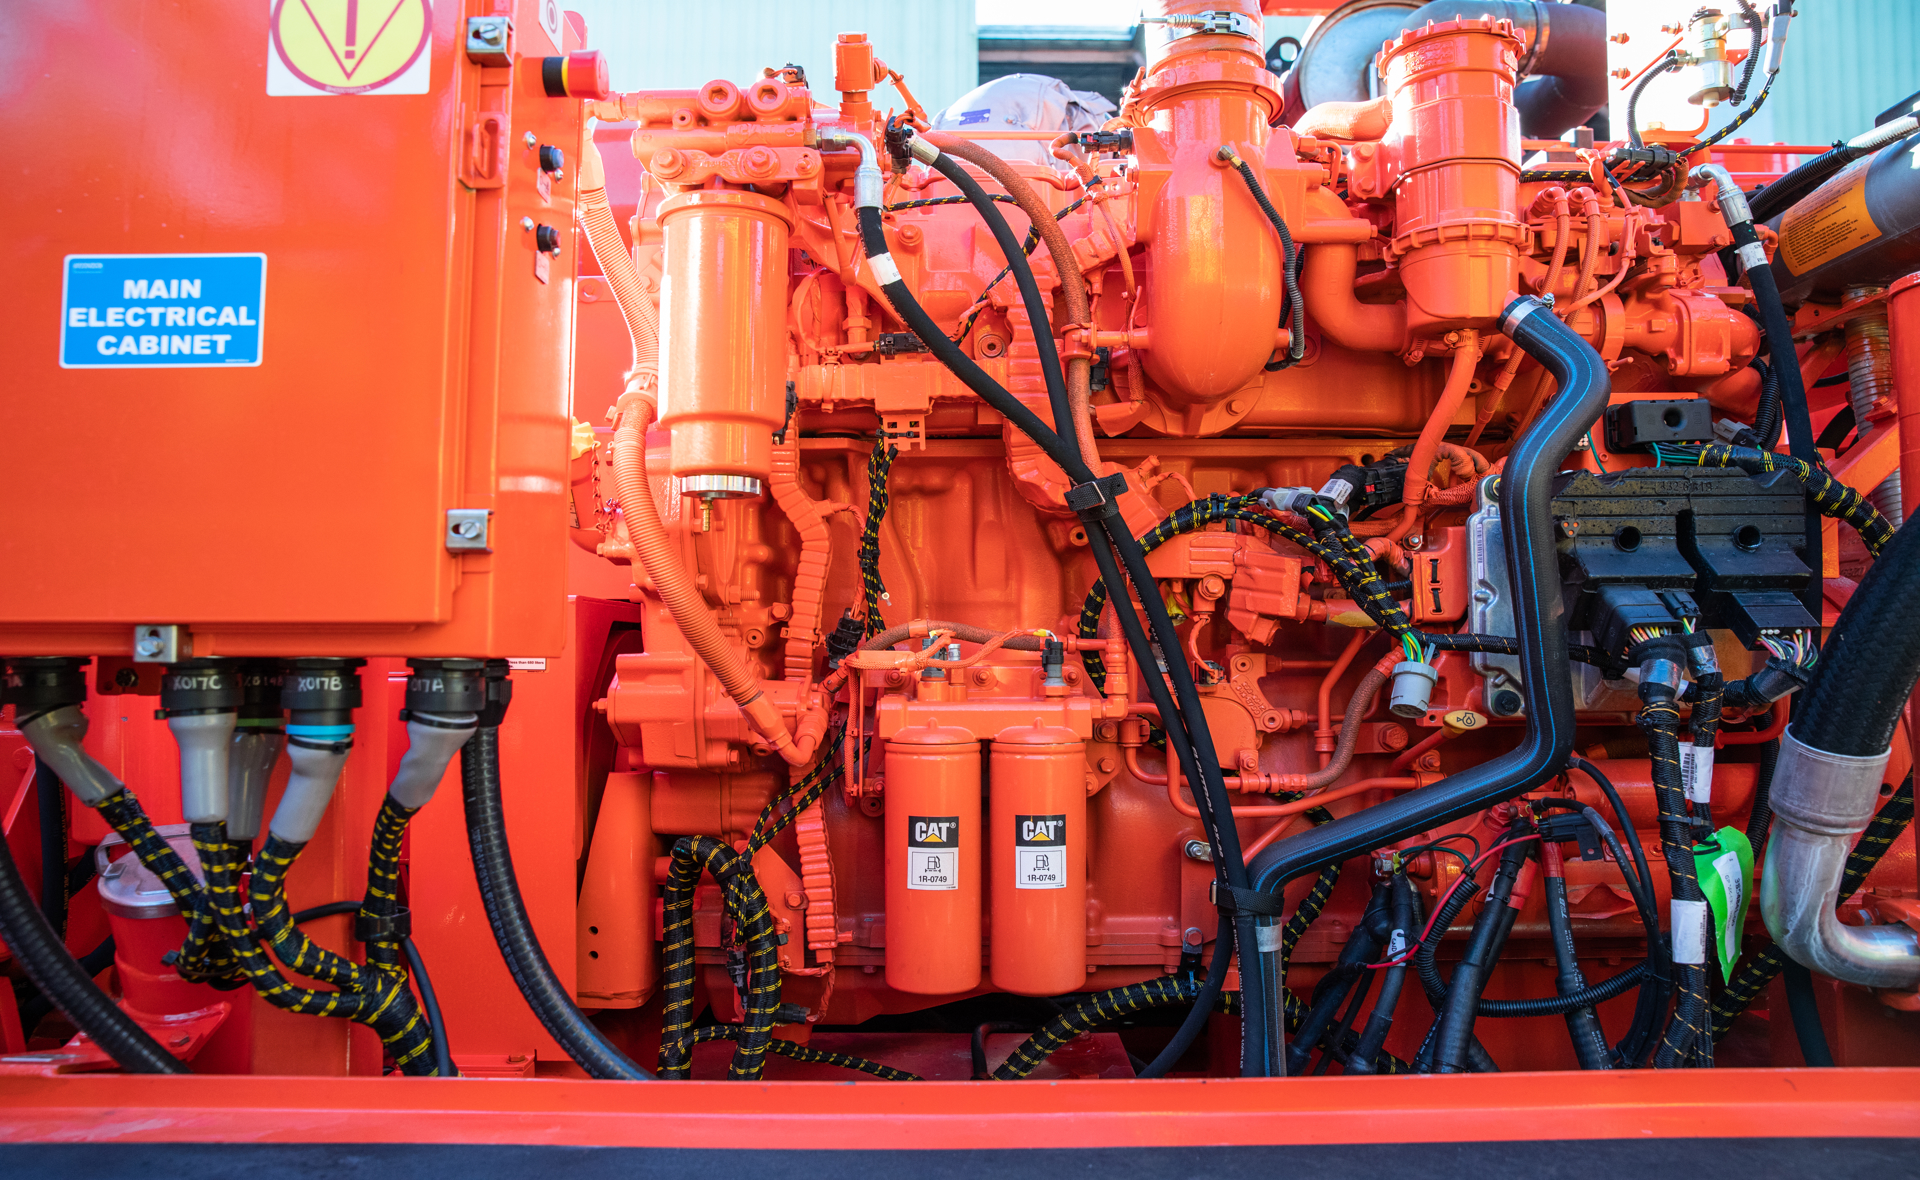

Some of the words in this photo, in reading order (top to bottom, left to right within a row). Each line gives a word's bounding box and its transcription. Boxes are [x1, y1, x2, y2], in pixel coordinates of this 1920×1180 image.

[123, 279, 202, 299] MAIN
[69, 306, 256, 328] ELECTRICAL
[97, 334, 232, 355] CABINET
[297, 676, 342, 692] X017B
[1027, 874, 1056, 882] 1R-0749
